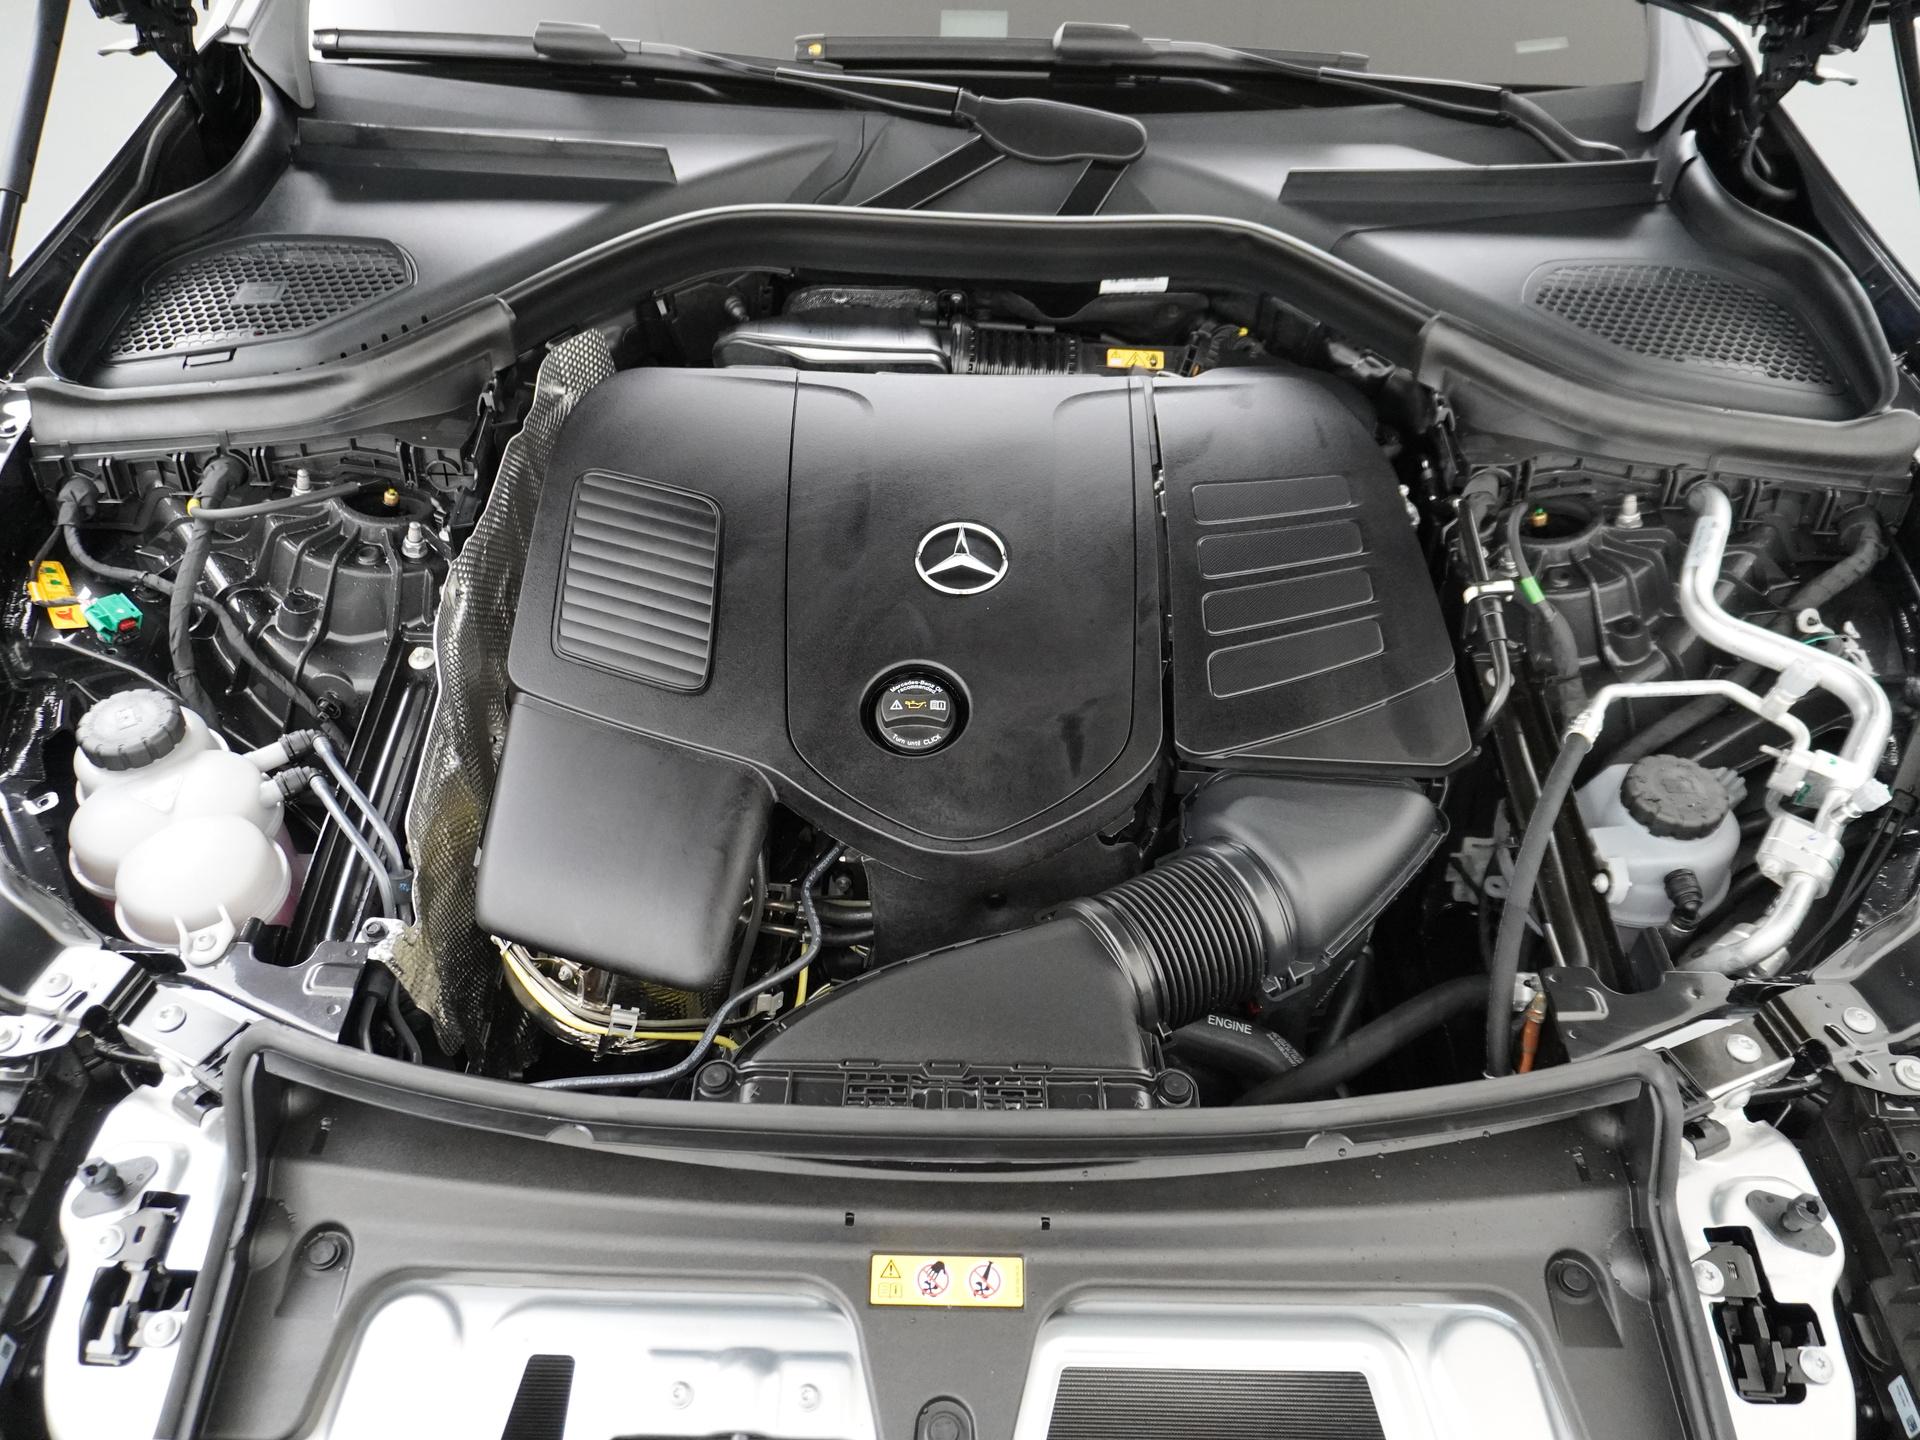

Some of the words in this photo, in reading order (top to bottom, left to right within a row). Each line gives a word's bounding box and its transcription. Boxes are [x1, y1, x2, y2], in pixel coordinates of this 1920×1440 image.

[889, 679, 935, 693] Mercedes-Benz
[892, 734, 906, 744] Turn
[923, 734, 942, 745] CLICK
[1207, 1014, 1253, 1035] ENGINE
